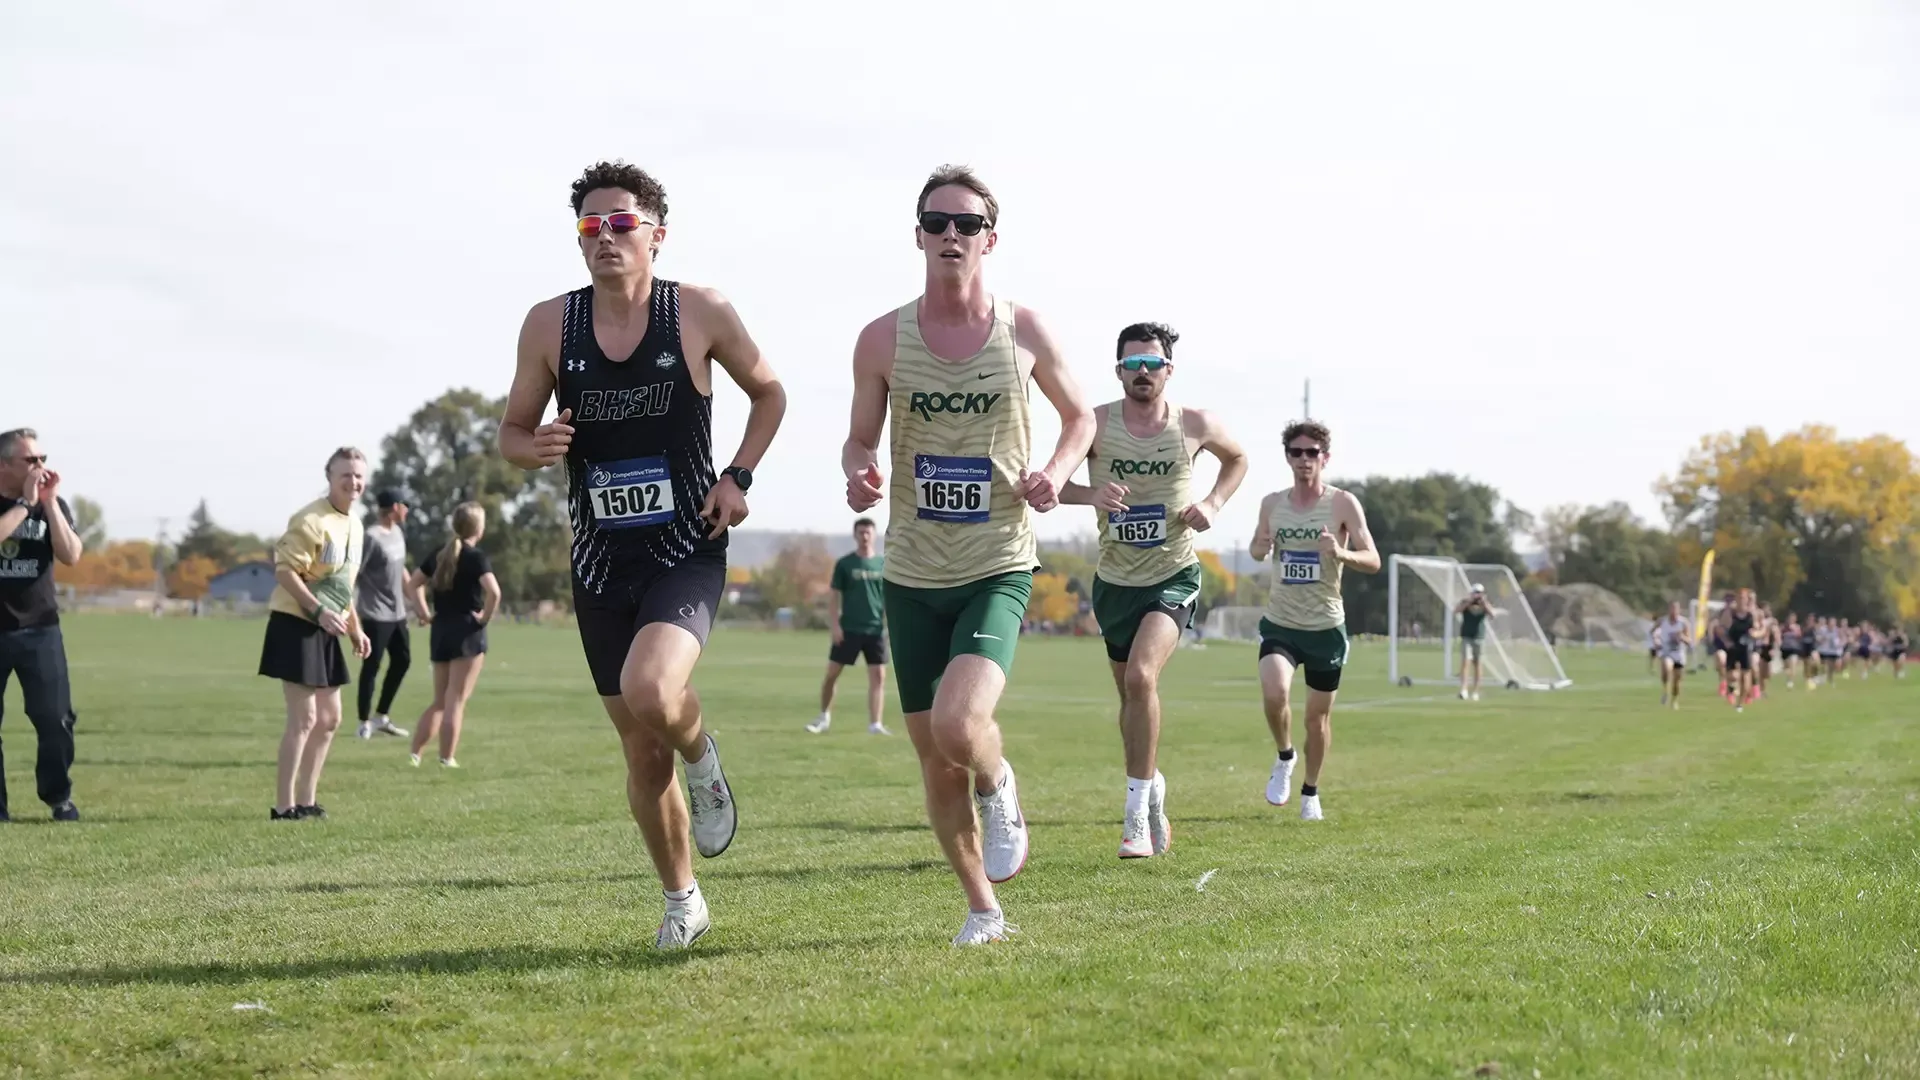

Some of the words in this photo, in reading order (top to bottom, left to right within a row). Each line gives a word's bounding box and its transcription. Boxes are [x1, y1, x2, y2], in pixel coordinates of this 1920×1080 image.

[577, 381, 674, 421] BHSU
[910, 392, 1002, 422] ROCKY
[1110, 459, 1175, 480] ROCKY
[598, 484, 663, 516] 1502
[921, 481, 981, 510] 1656
[1115, 521, 1159, 541] 1652
[1275, 528, 1322, 544] ROCKY
[1284, 564, 1313, 579] 1651
